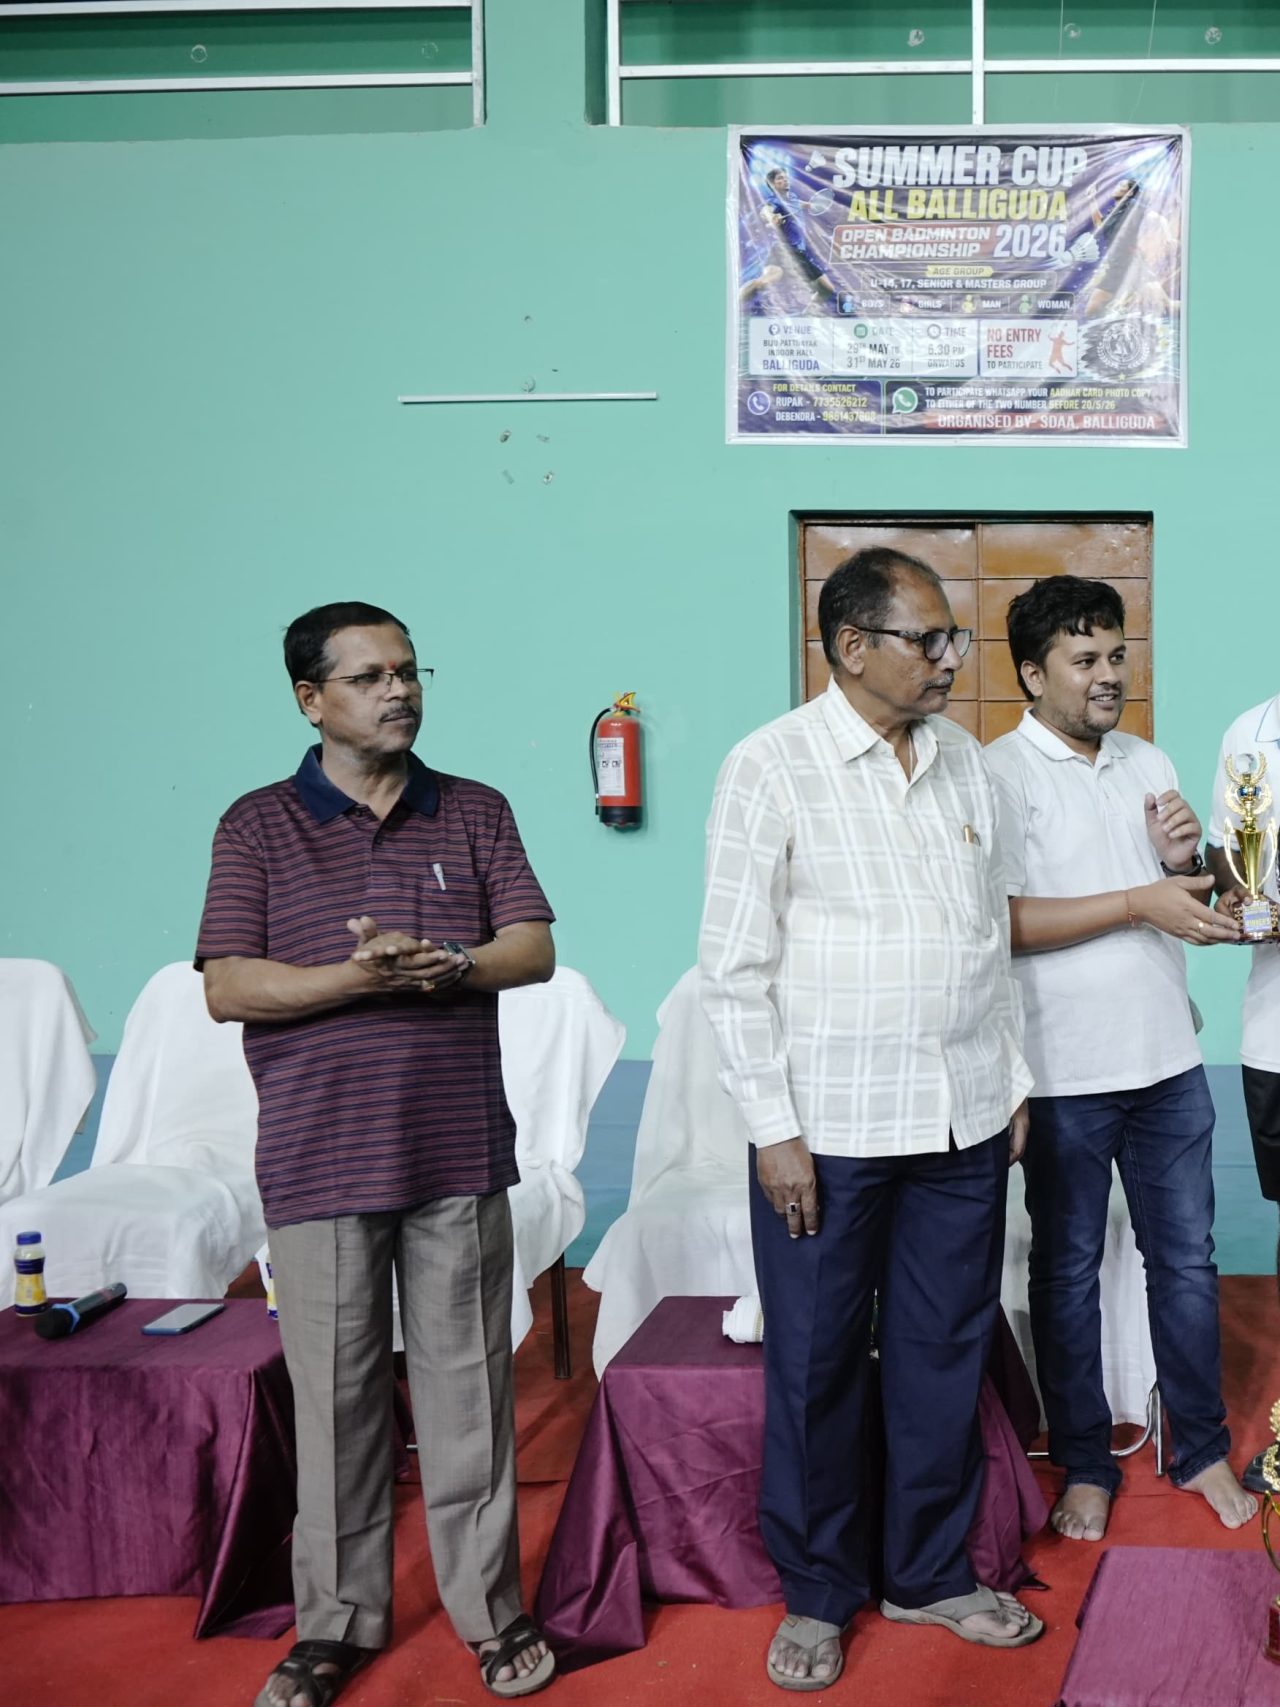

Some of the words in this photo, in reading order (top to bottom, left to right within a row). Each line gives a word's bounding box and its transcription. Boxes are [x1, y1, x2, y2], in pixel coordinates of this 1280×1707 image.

[833, 145, 1000, 188] SUMMER
[1012, 146, 1088, 188] CUP
[848, 189, 899, 221] ALL
[907, 188, 1068, 221] BALLIGUDA
[841, 229, 887, 242] OPEN
[892, 227, 991, 241] BADMINTON
[993, 224, 1067, 258] 2026
[840, 243, 981, 259] CHAMPIONSHIP
[932, 267, 951, 276] AGE
[953, 267, 985, 276] GROUP
[917, 279, 954, 288] SENIOR
[955, 279, 963, 288] &
[965, 279, 1011, 288] MASTERS
[1013, 279, 1047, 289] GROUP
[982, 300, 1002, 308] MAN
[783, 326, 812, 334] VENUE
[944, 327, 967, 337] TIME
[987, 328, 1002, 342] NO
[1006, 328, 1041, 342] ENTRY
[869, 344, 889, 354] MAY
[987, 345, 1013, 358] FEES
[763, 360, 820, 371] BALLIGUDA
[868, 358, 887, 368] MAY
[987, 360, 996, 369] TO
[998, 360, 1043, 369] PARTICIPATE
[773, 384, 788, 392] FOR
[822, 384, 856, 393] CONTACT
[925, 387, 935, 396] TO
[937, 387, 983, 397] PARTICIPATE
[984, 387, 1025, 397] WHATSAPP
[1027, 388, 1048, 397] YOUR
[1050, 388, 1081, 397] AADHAR
[1082, 388, 1103, 397] CARD
[1105, 388, 1129, 397] PHOTO
[776, 397, 803, 407] RUPAK
[925, 399, 935, 408] TO
[979, 400, 994, 409] THE
[995, 400, 1012, 409] TWO
[1014, 400, 1047, 409] NUMBER
[1049, 400, 1079, 409] BEFORE
[776, 411, 816, 421] DEBENDRA
[938, 414, 1011, 428] ORGANISED
[1083, 415, 1156, 430] BALLIGUDA
